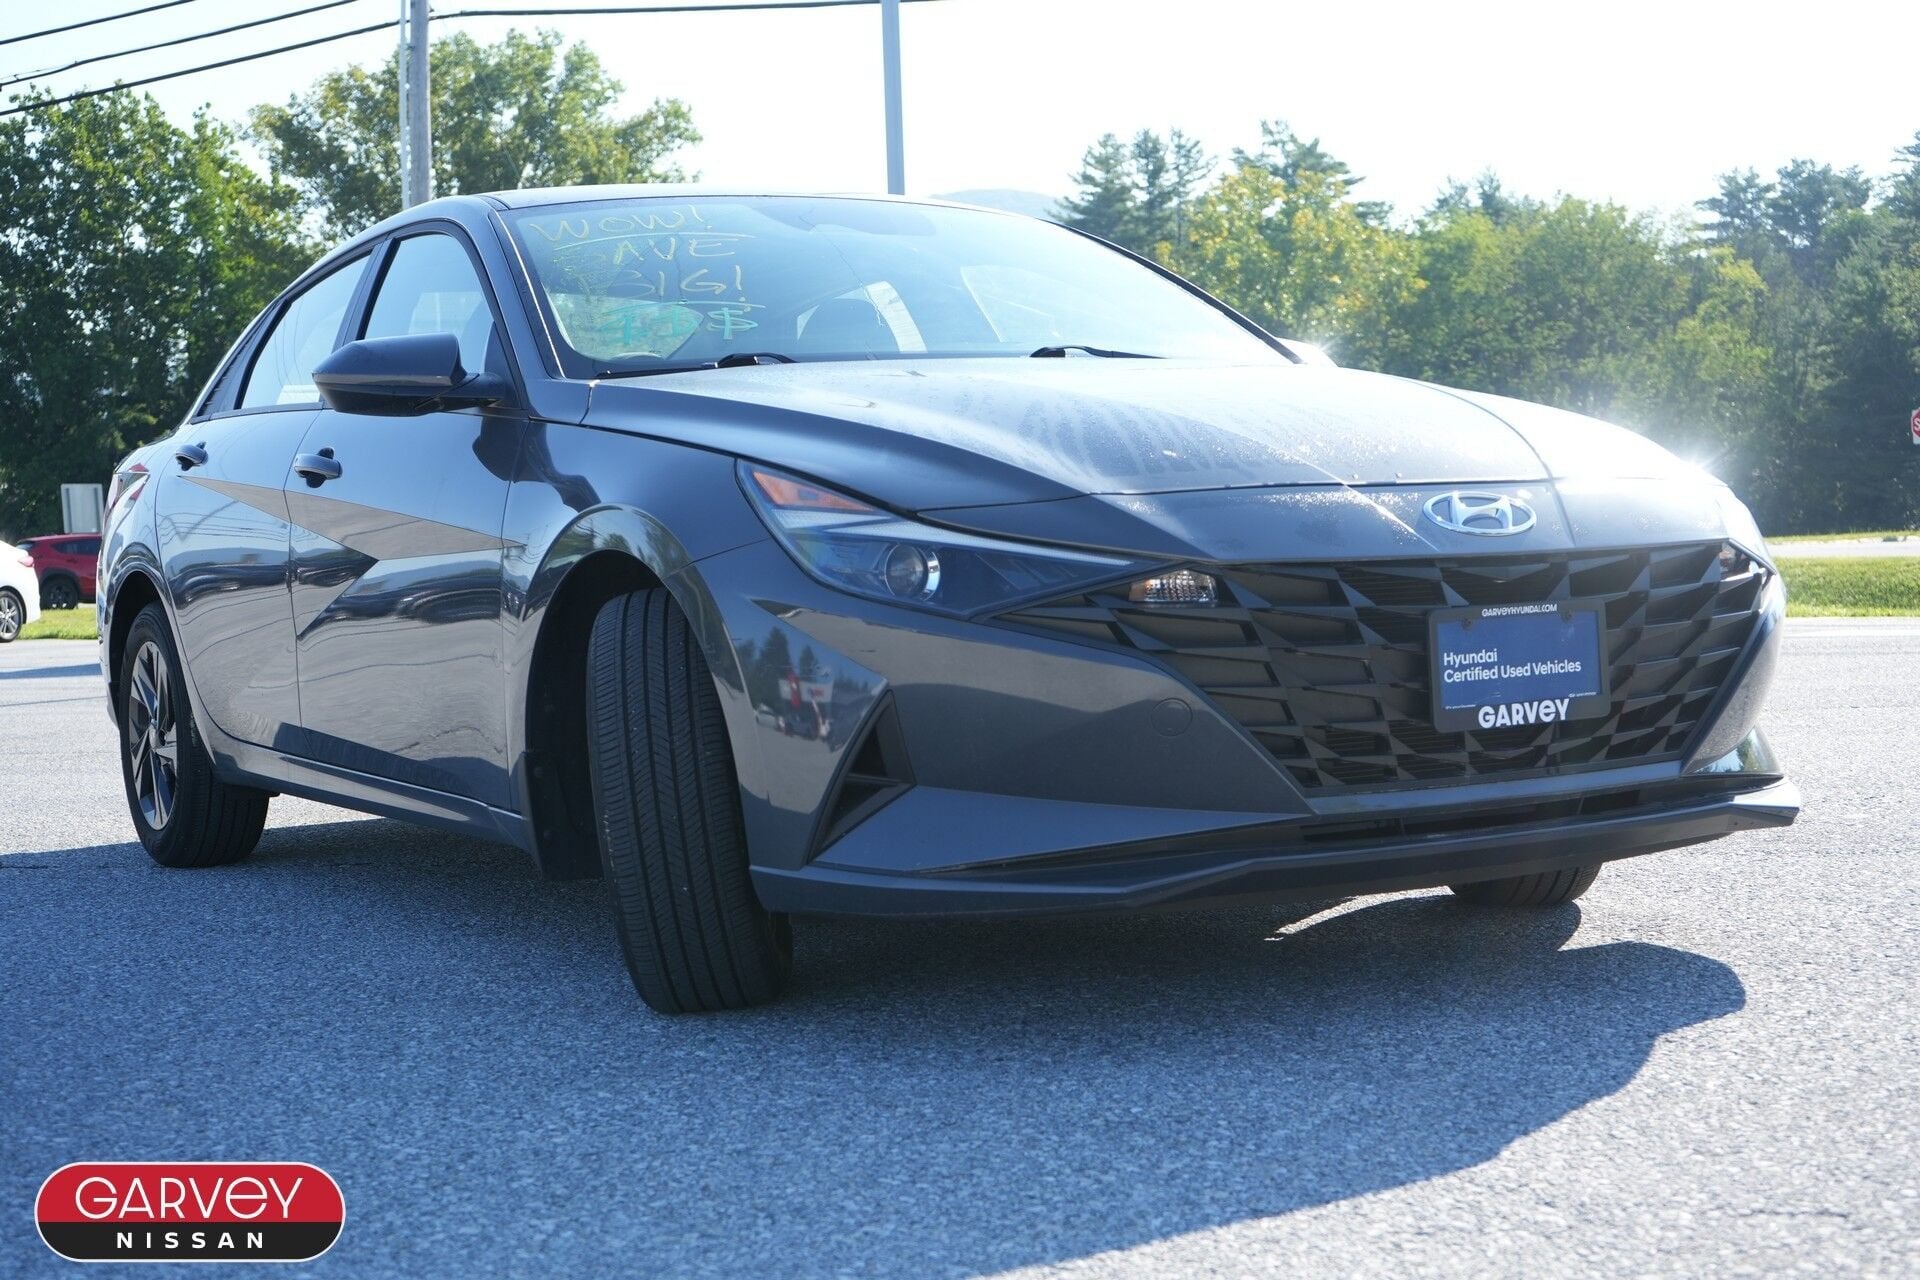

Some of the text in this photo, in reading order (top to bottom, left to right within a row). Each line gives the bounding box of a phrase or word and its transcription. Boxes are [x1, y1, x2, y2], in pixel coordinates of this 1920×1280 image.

[529, 204, 713, 242] WOW!
[571, 236, 741, 268] AVE
[1443, 648, 1498, 668] Hyundai
[1444, 659, 1581, 683] Certified Used Vehicles
